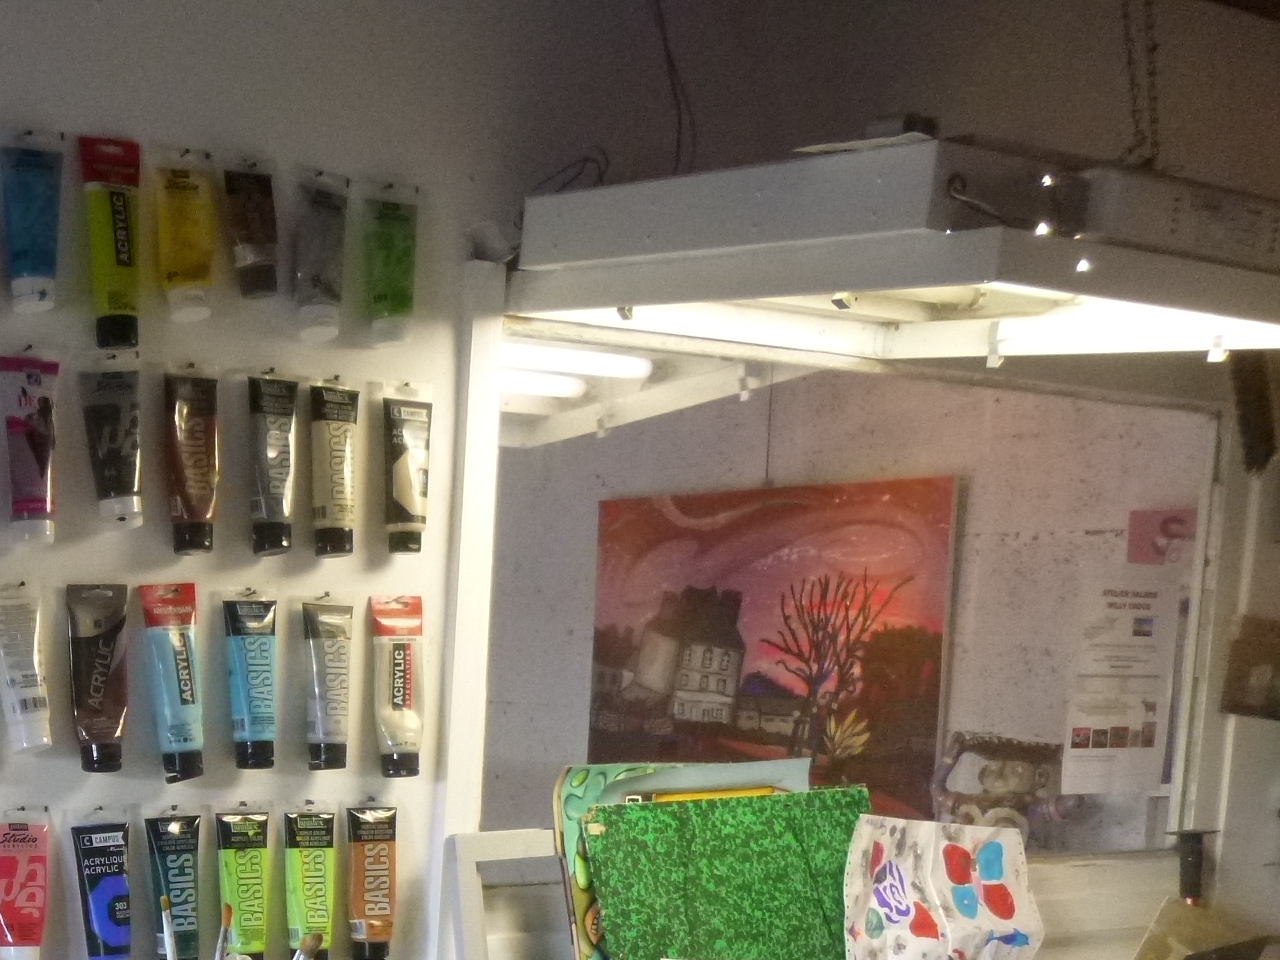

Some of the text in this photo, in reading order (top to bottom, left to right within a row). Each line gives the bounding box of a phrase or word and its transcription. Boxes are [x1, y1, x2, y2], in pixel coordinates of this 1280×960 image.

[112, 194, 130, 264] ACRYLIC
[87, 638, 115, 712] ACRYLIC
[174, 632, 193, 702] ACRYLIC
[244, 635, 273, 715] BASICS
[323, 637, 349, 717] BASICS
[393, 649, 405, 706] ACRYLIC
[84, 864, 119, 875] ACRYLIC
[94, 834, 120, 845] CAMPUS
[114, 901, 127, 910] 303
[166, 853, 198, 932] BASICS
[234, 849, 265, 928] BASICS
[301, 849, 330, 924] BASICS
[364, 842, 391, 917] BASICS
